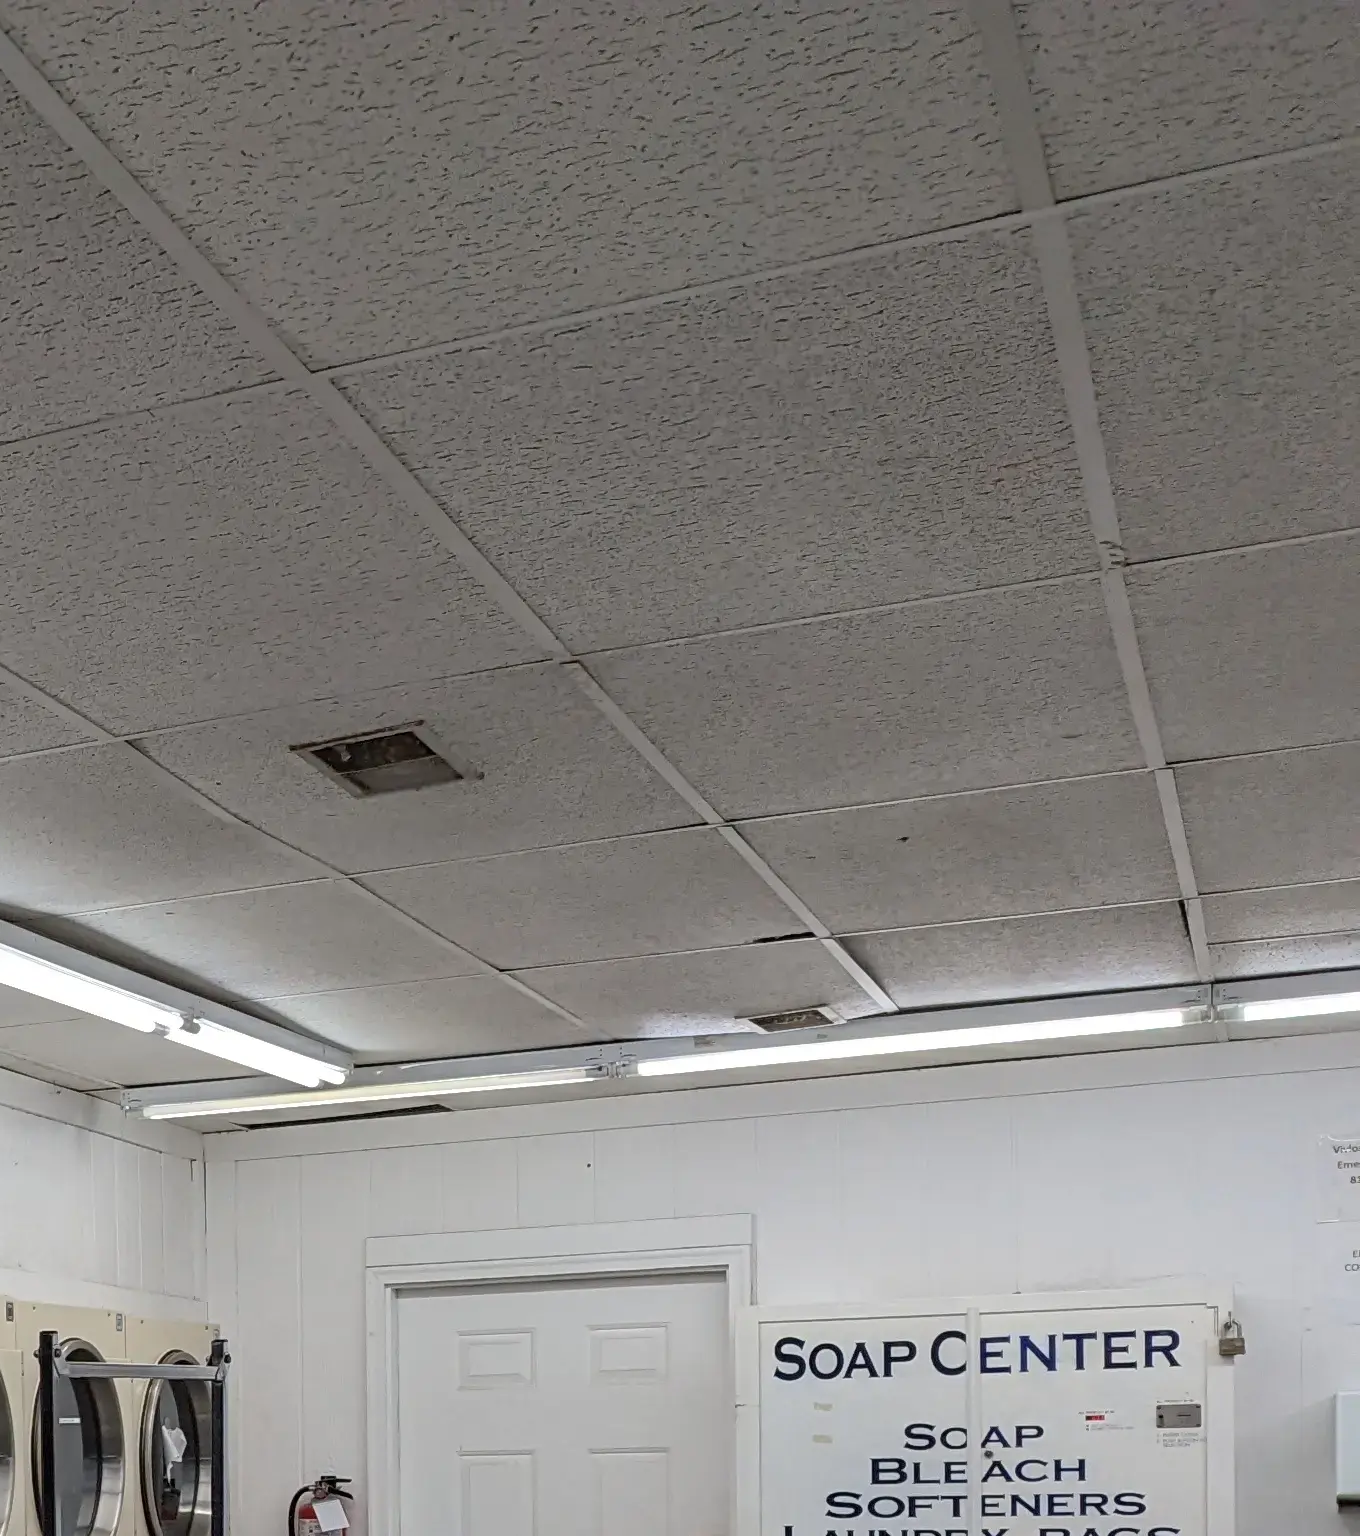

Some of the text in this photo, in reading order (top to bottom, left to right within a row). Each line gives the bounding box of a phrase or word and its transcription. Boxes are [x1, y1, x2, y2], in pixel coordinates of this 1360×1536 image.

[773, 1329, 1181, 1380] SOAP CENTER
[904, 1423, 1044, 1450] SOAP
[870, 1458, 1086, 1485] BLEACH
[825, 1492, 1147, 1519] SOFTENERS
